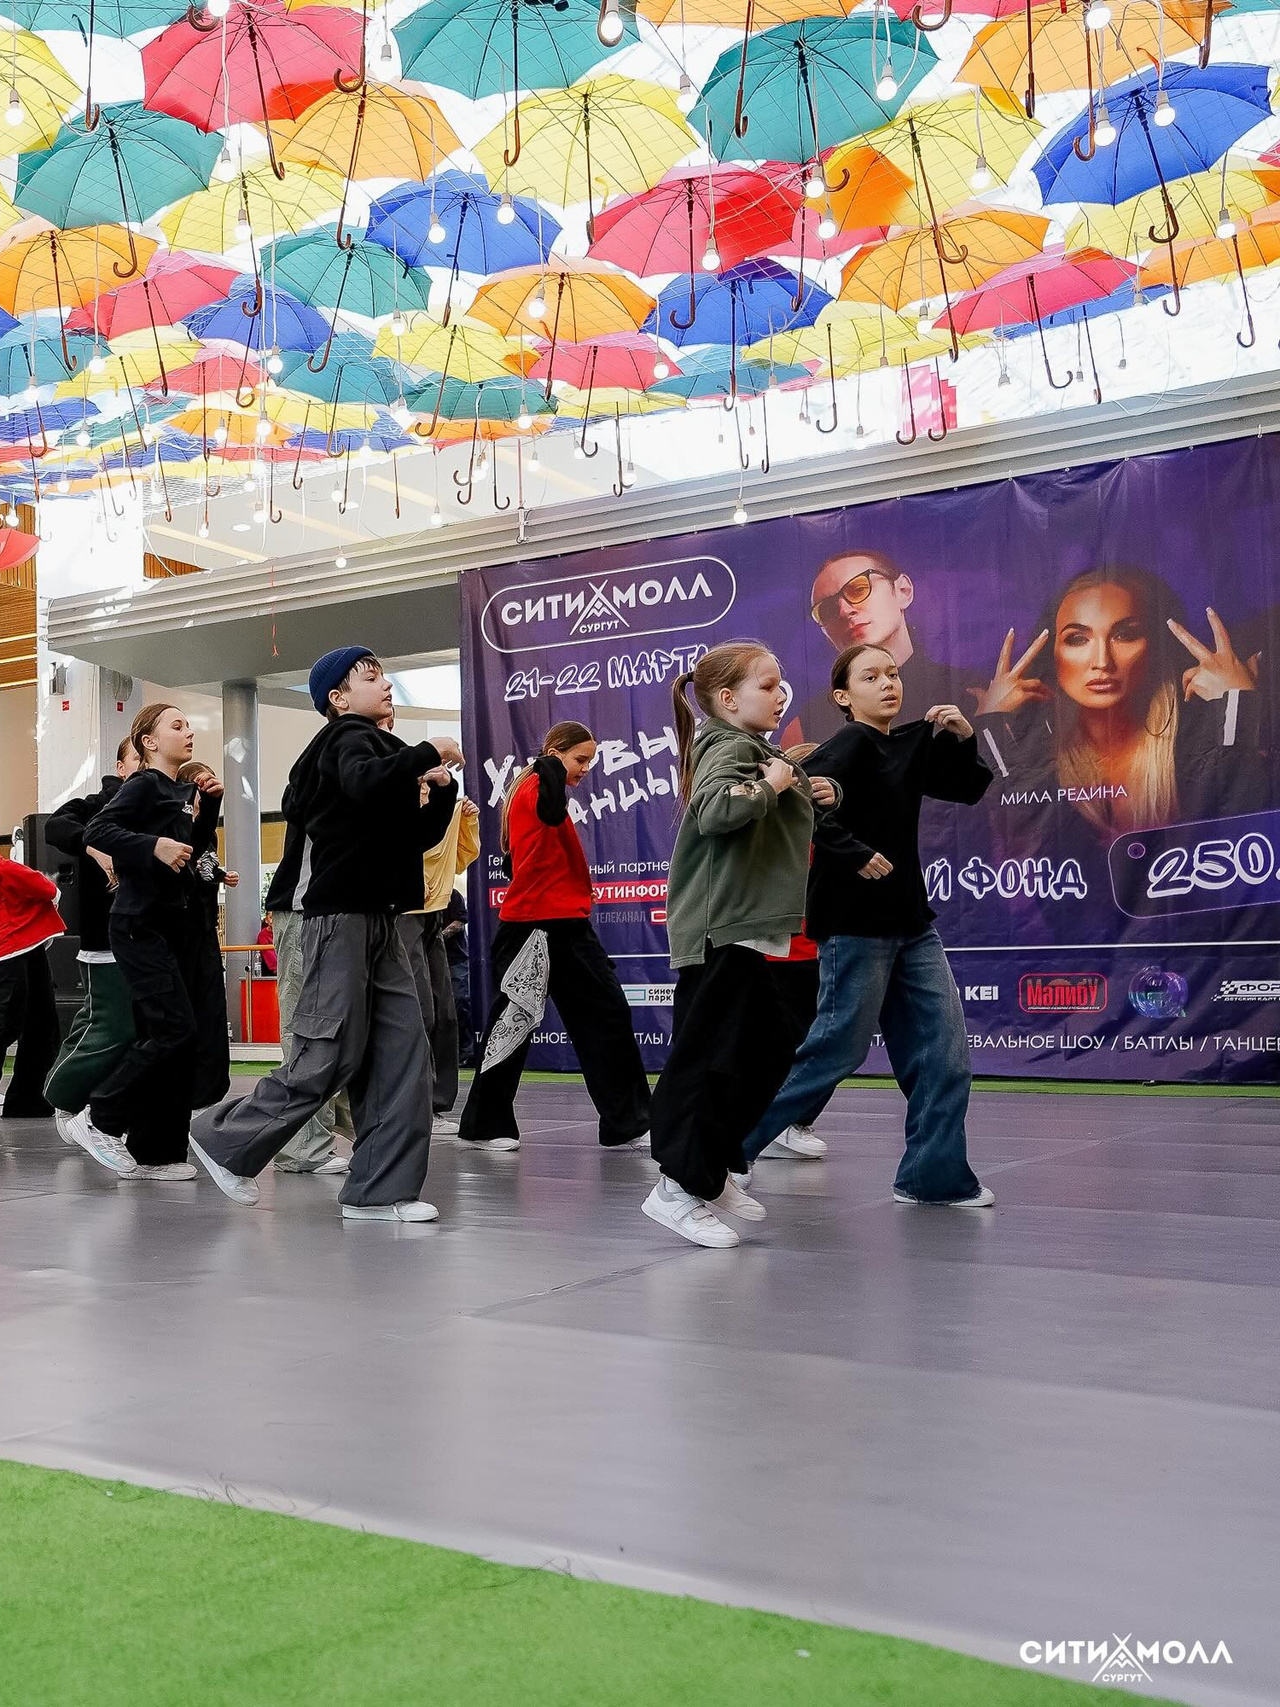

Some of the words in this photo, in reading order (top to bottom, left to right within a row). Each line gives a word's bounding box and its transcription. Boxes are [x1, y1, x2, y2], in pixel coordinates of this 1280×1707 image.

[501, 590, 586, 626] СИТИ
[612, 572, 713, 609] МОЛЛ
[579, 619, 620, 634] СУРГУТ
[503, 661, 601, 702] 21-22
[567, 765, 669, 825] АНЦЫ
[1000, 792, 1053, 806] МИЛА
[1057, 784, 1128, 802] РЕДИНА
[619, 860, 669, 876] партне
[958, 856, 1088, 901] ФОНД
[595, 910, 646, 925] ТЕЛЕКАНАЛ
[648, 995, 671, 1003] парк
[964, 985, 999, 1001] KEI
[1059, 1034, 1106, 1050] ШОУ
[1124, 1035, 1194, 1051] БАТТЛЫ
